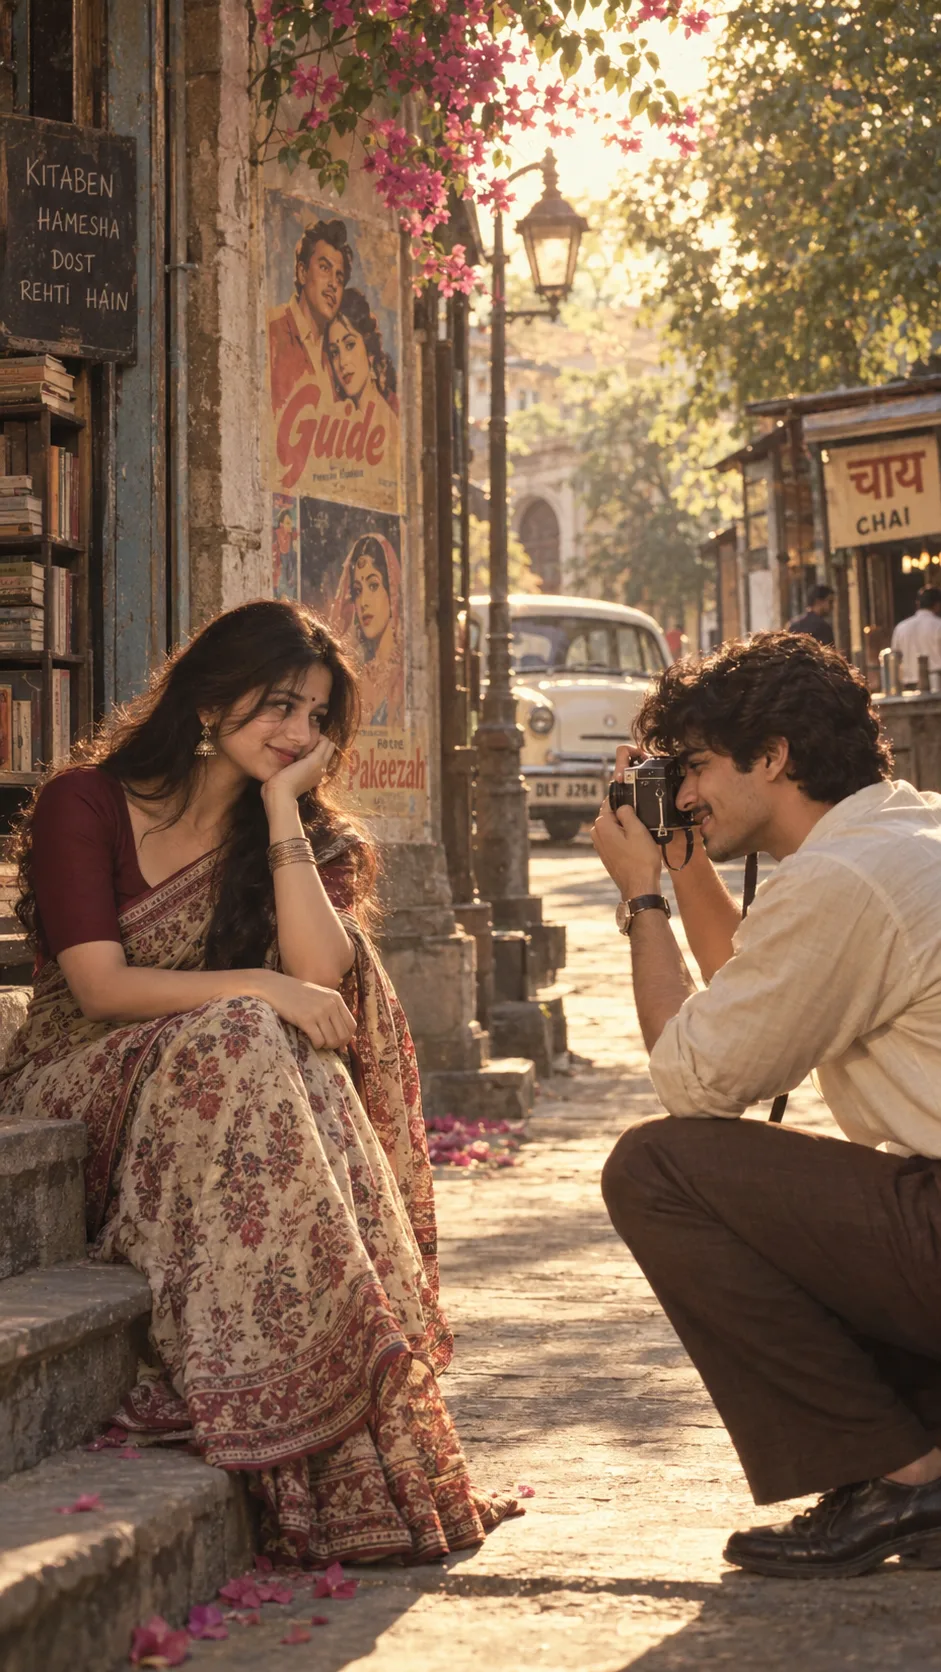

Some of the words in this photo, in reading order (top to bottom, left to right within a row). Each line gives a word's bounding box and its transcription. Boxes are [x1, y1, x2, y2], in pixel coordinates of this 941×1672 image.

[26, 156, 114, 199] KITABEN
[37, 206, 120, 240] HAMESHA
[51, 249, 96, 273] DOST
[86, 287, 129, 312] HAIN
[276, 383, 386, 489] Guide
[846, 449, 926, 501] चाय
[856, 506, 910, 535] CHAI
[347, 747, 426, 792] Pakeezah
[536, 783, 559, 797] DLT
